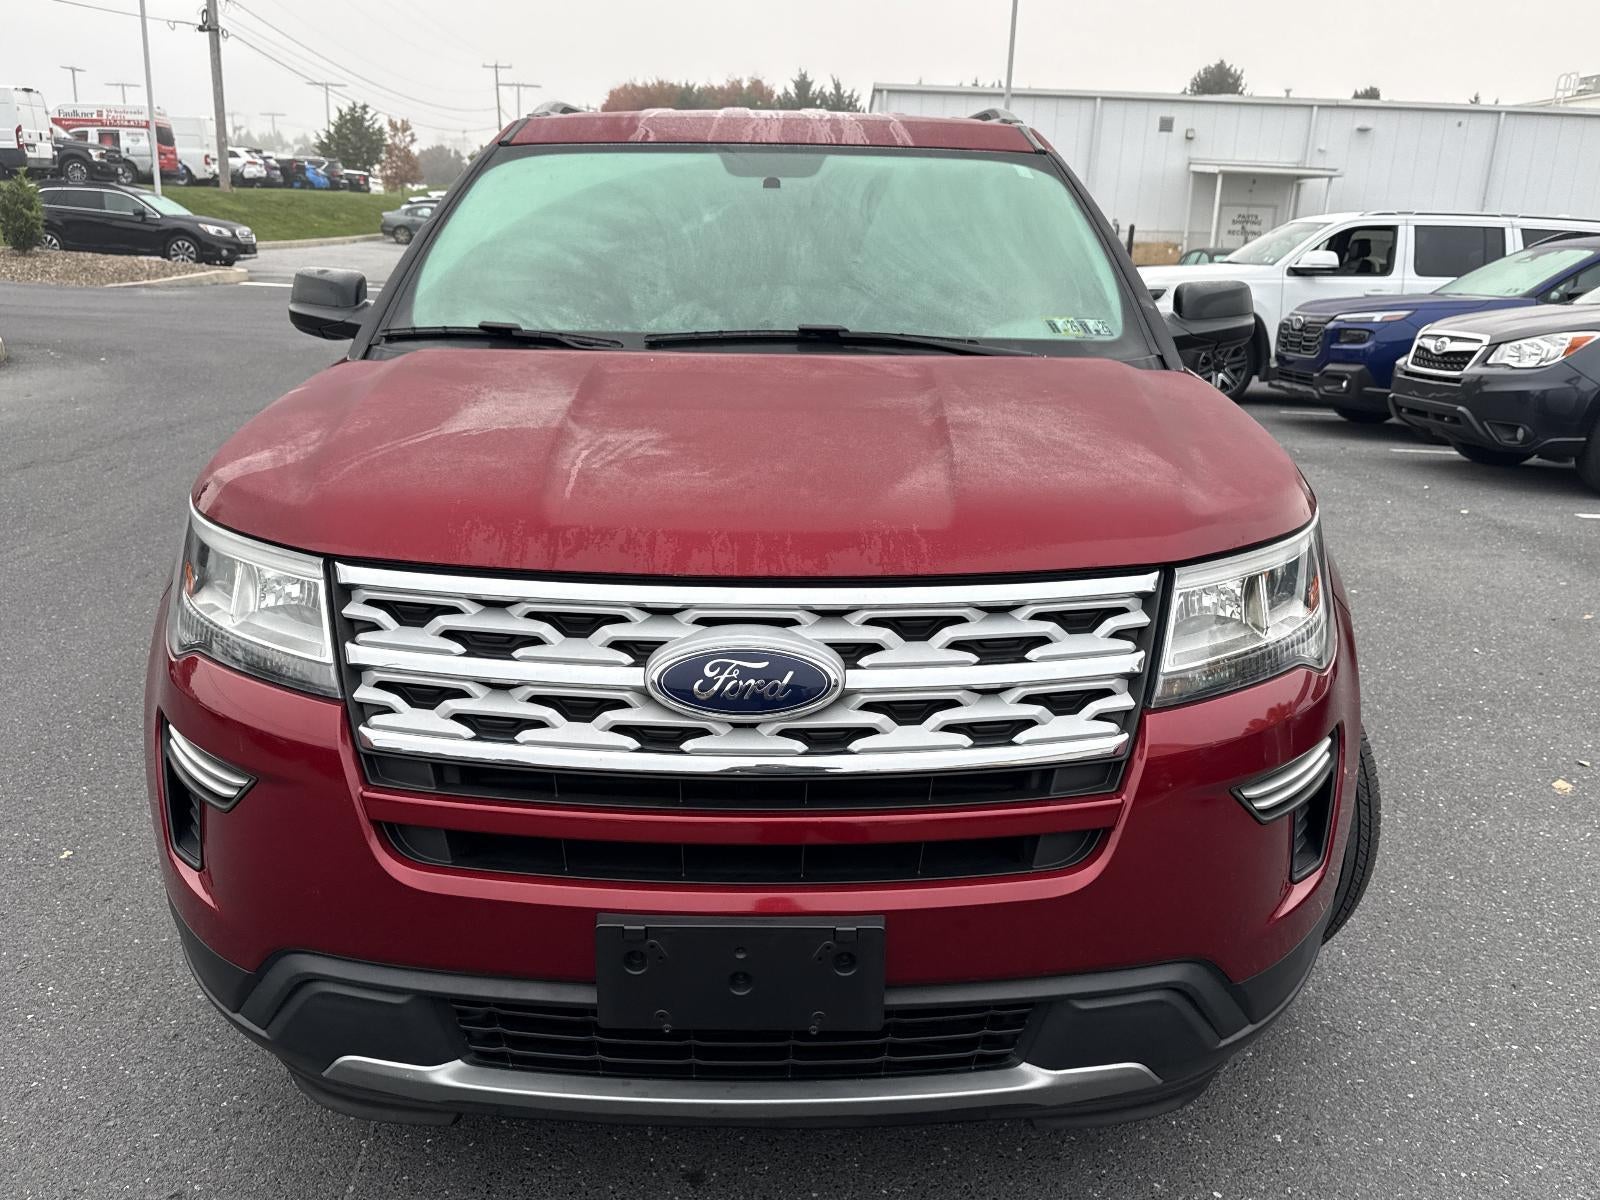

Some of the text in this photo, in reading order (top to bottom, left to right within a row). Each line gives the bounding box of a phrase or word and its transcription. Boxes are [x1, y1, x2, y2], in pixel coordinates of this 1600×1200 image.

[58, 109, 95, 118] Faulkner
[1232, 218, 1262, 226] SHIPPING
[693, 658, 794, 700] Ford
